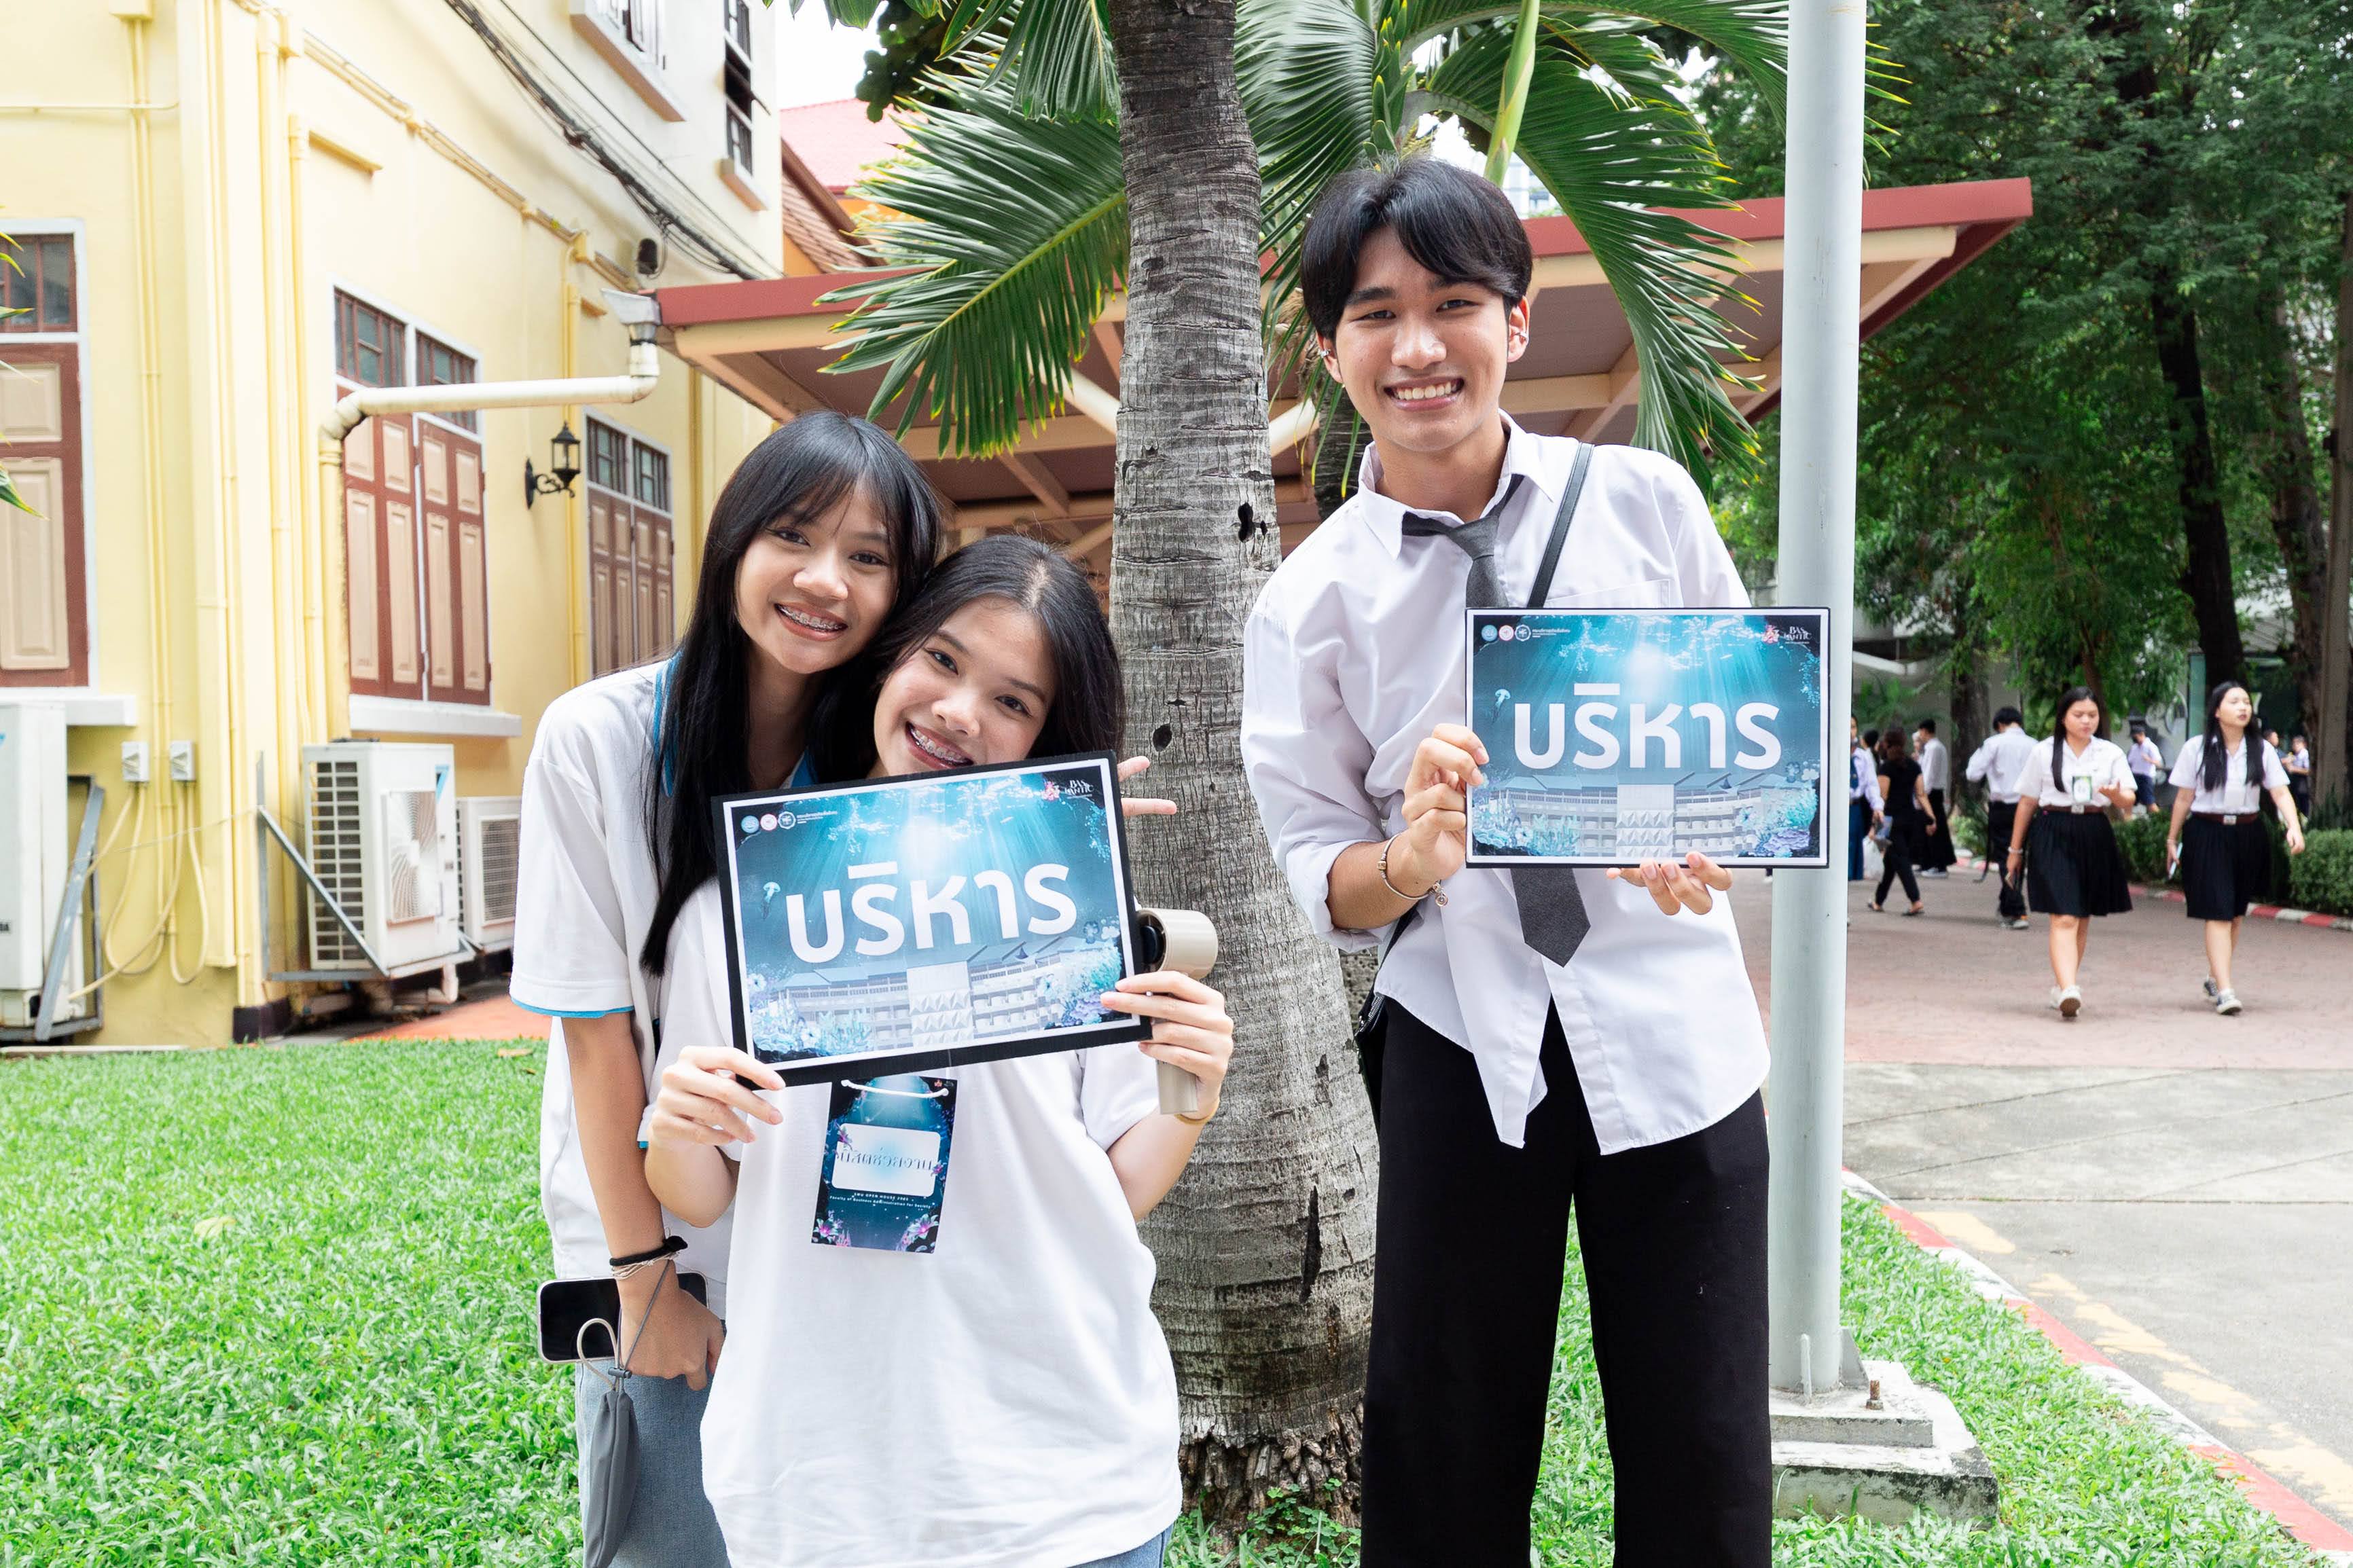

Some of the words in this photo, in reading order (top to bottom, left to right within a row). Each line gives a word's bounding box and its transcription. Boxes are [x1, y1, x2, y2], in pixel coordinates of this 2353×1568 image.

[1514, 682, 1782, 770] บริหาร
[785, 861, 1077, 964] บริหาร
